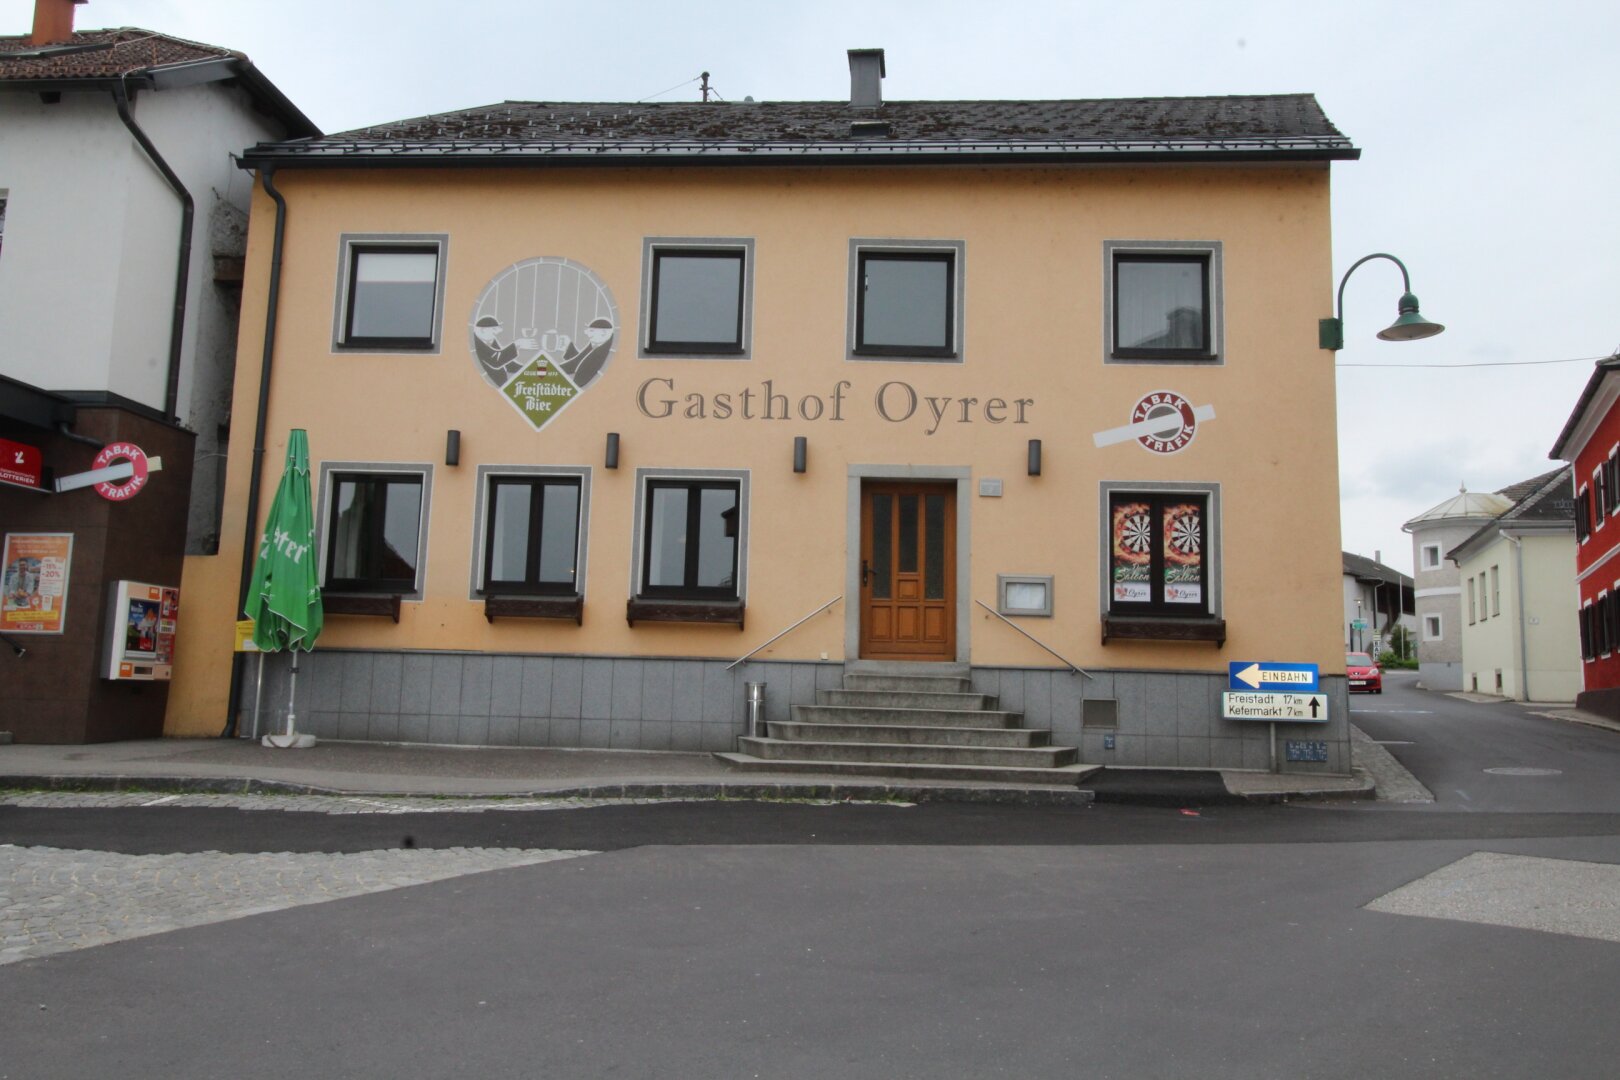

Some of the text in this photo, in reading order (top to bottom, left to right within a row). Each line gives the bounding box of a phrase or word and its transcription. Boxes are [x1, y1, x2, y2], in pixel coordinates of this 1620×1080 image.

[525, 396, 552, 411] Bier
[636, 377, 1034, 436] Gasthof Oyrer
[1134, 393, 1186, 420] TABAK
[1144, 424, 1194, 452] TRAFIK
[97, 445, 140, 463] TABAK
[0, 472, 35, 484] LOTTERIEN
[101, 475, 144, 498] TRAFIK
[41, 570, 61, 578] -20%
[1114, 568, 1150, 583] Saloon
[1164, 569, 1200, 584] Saloon
[1262, 671, 1308, 682] EINBAHN
[1228, 693, 1303, 705] Freistadt 17 km
[1229, 705, 1304, 717] Kefermarkt 7 km
